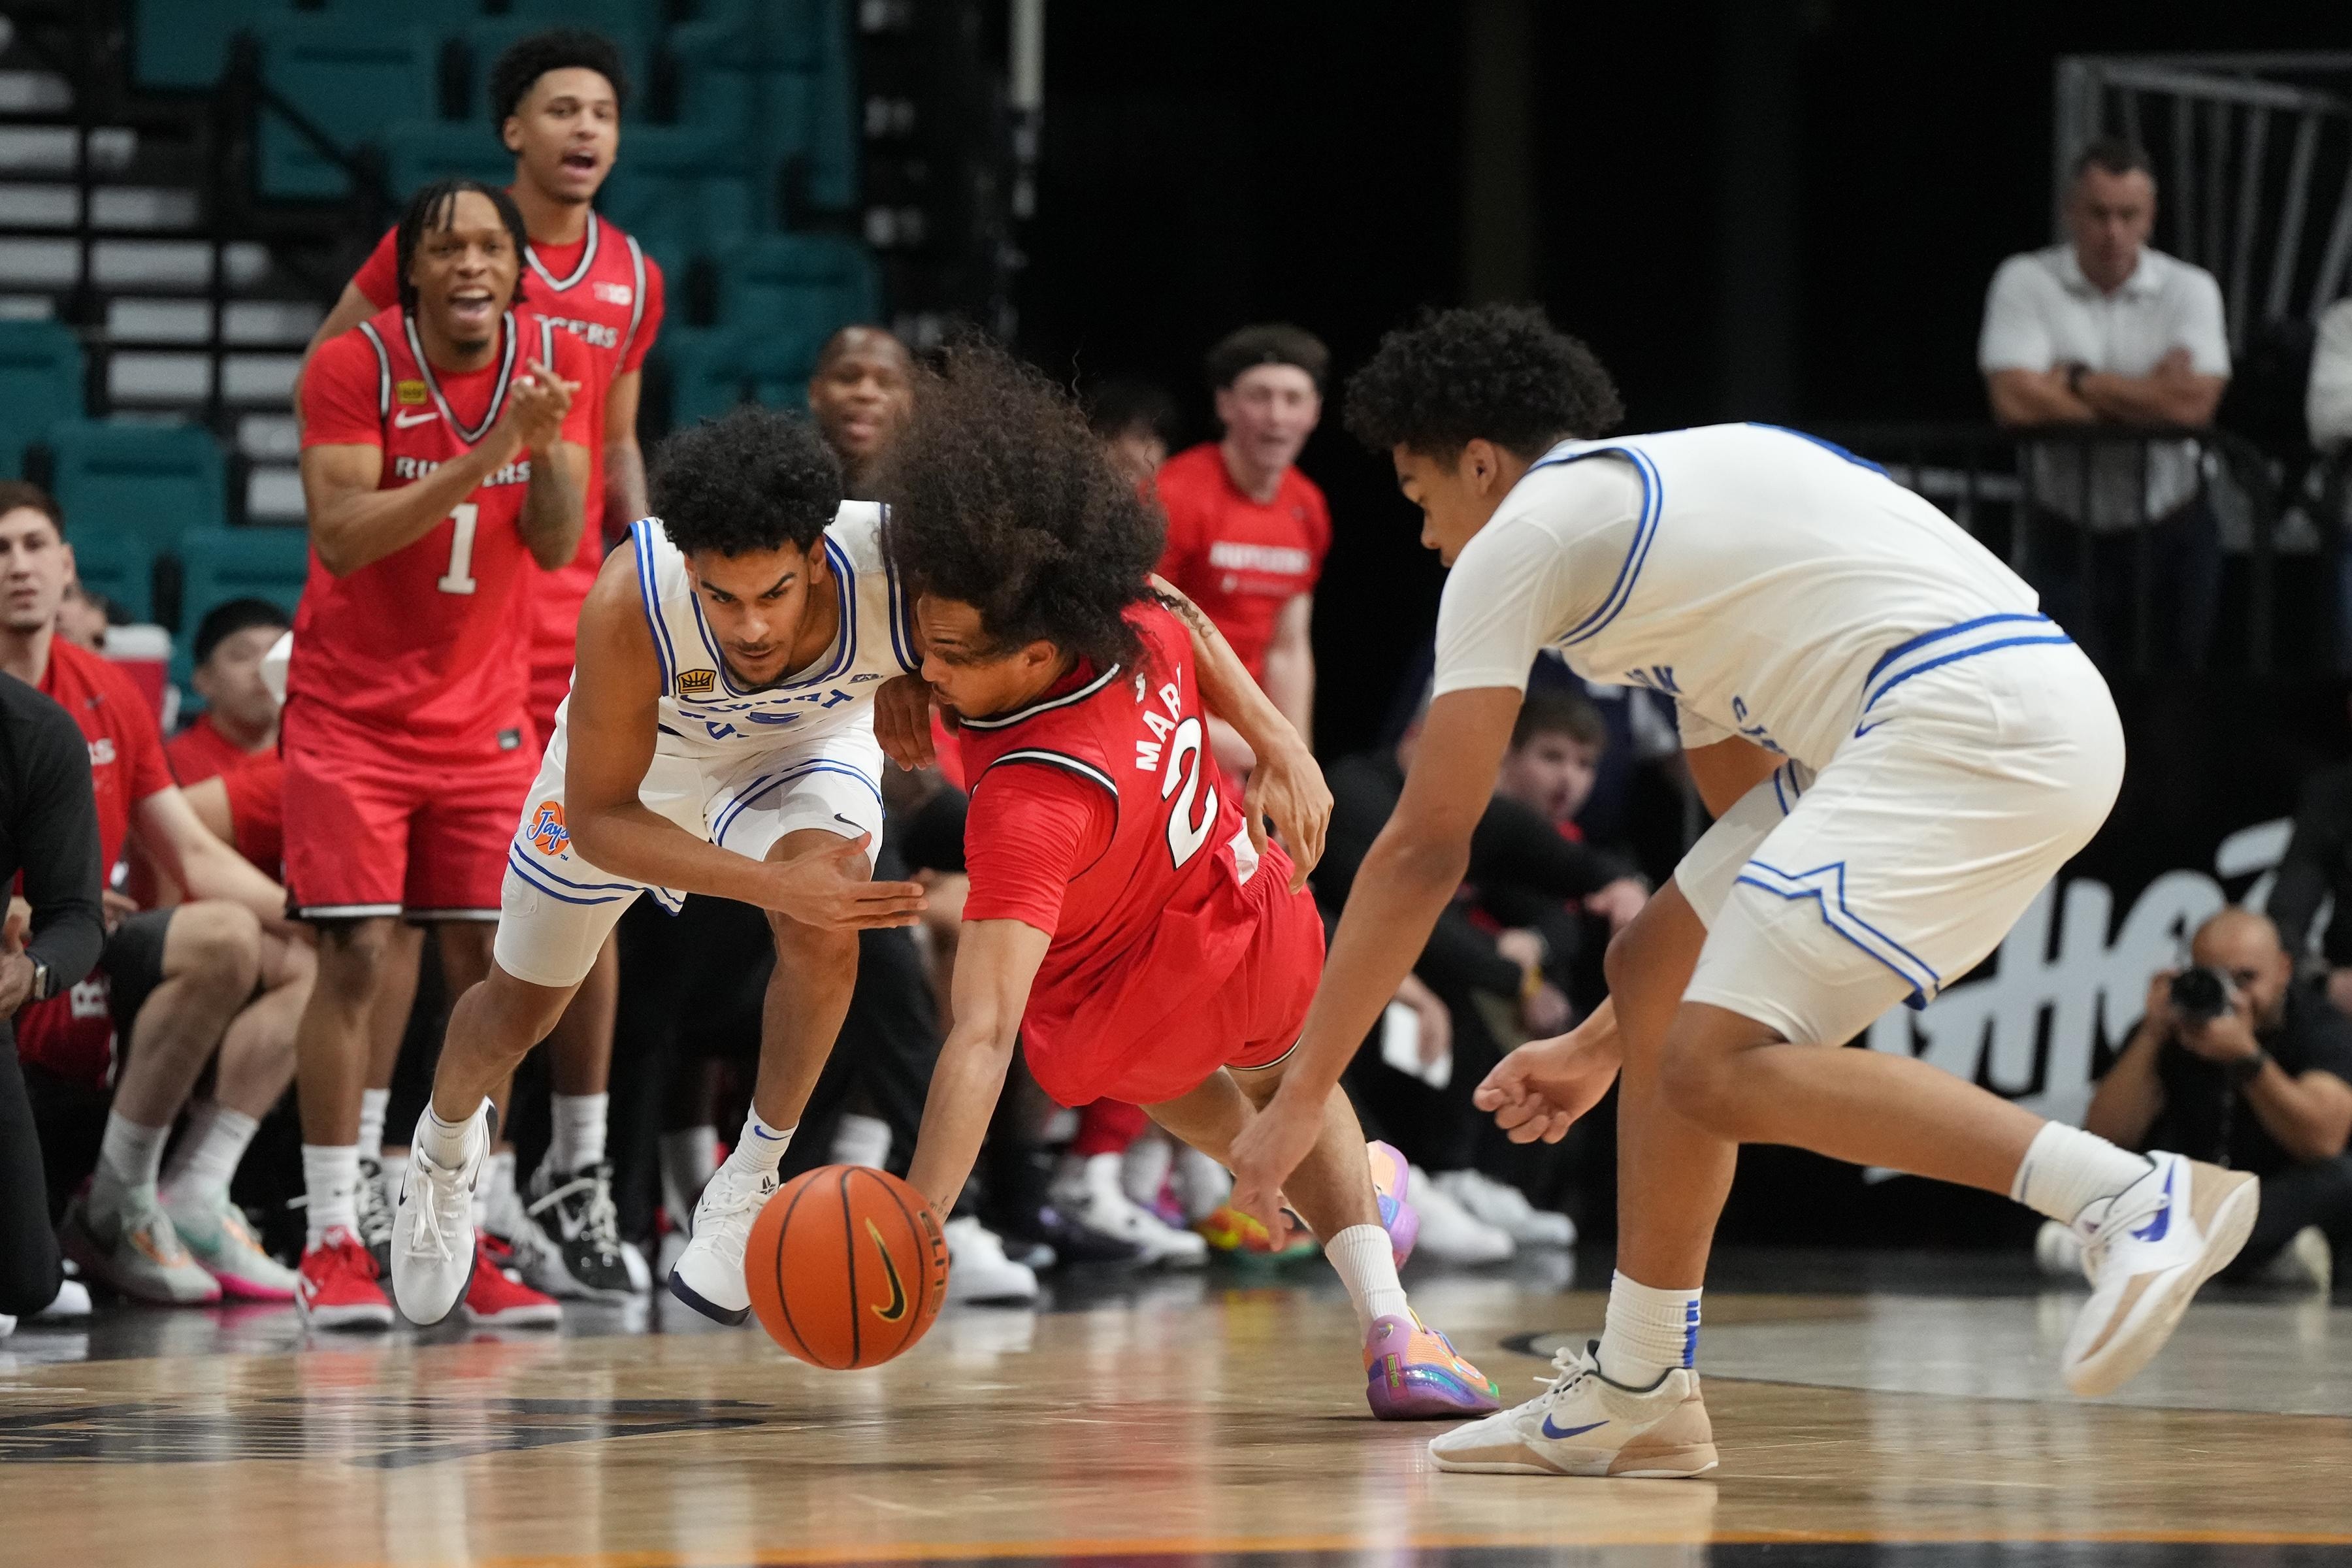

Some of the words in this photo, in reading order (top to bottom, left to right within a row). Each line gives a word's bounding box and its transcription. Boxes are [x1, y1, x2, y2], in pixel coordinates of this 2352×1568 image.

[437, 502, 480, 595] 1
[1135, 661, 1182, 772] MAR
[526, 809, 570, 851] Jays
[1161, 715, 1219, 872] 2
